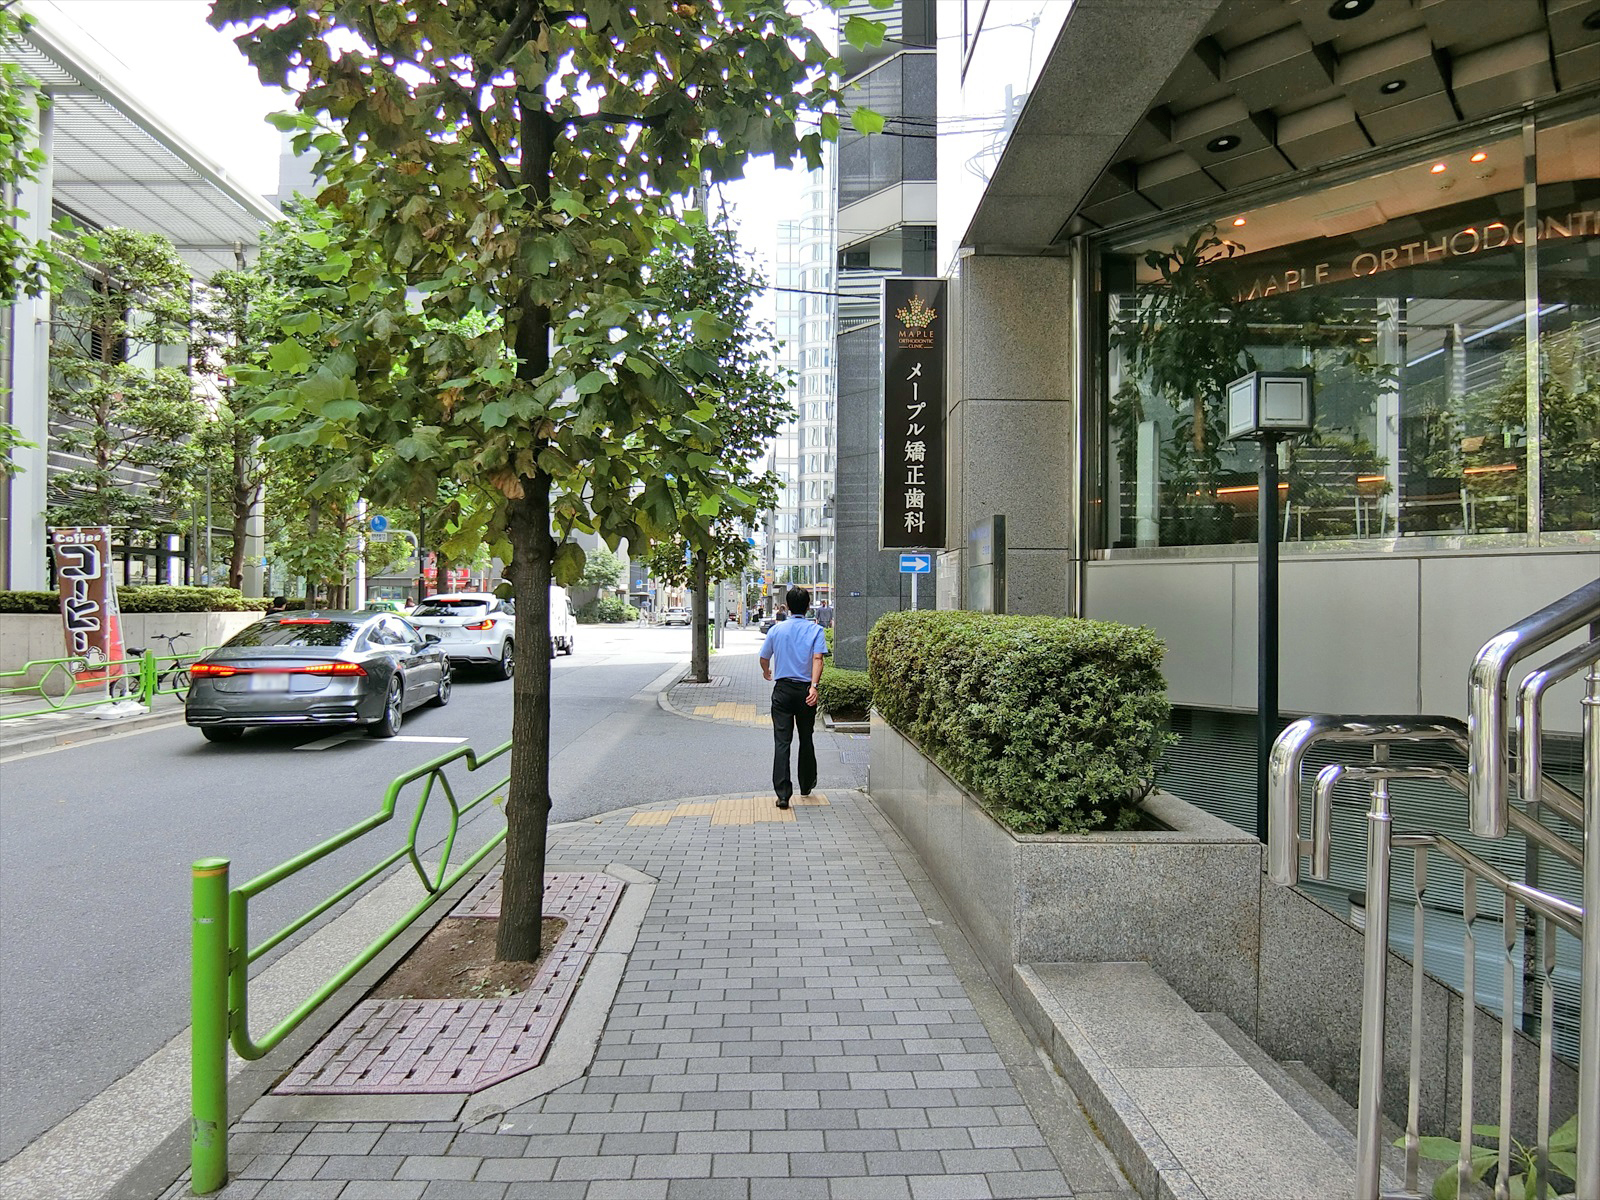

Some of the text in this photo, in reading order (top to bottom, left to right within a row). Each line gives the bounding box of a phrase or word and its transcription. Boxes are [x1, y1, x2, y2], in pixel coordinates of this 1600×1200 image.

[898, 330, 934, 338] MAPLE
[903, 361, 927, 534] メープル矯正歯科
[55, 533, 102, 544] Coffee
[58, 544, 101, 652] コーヒー
